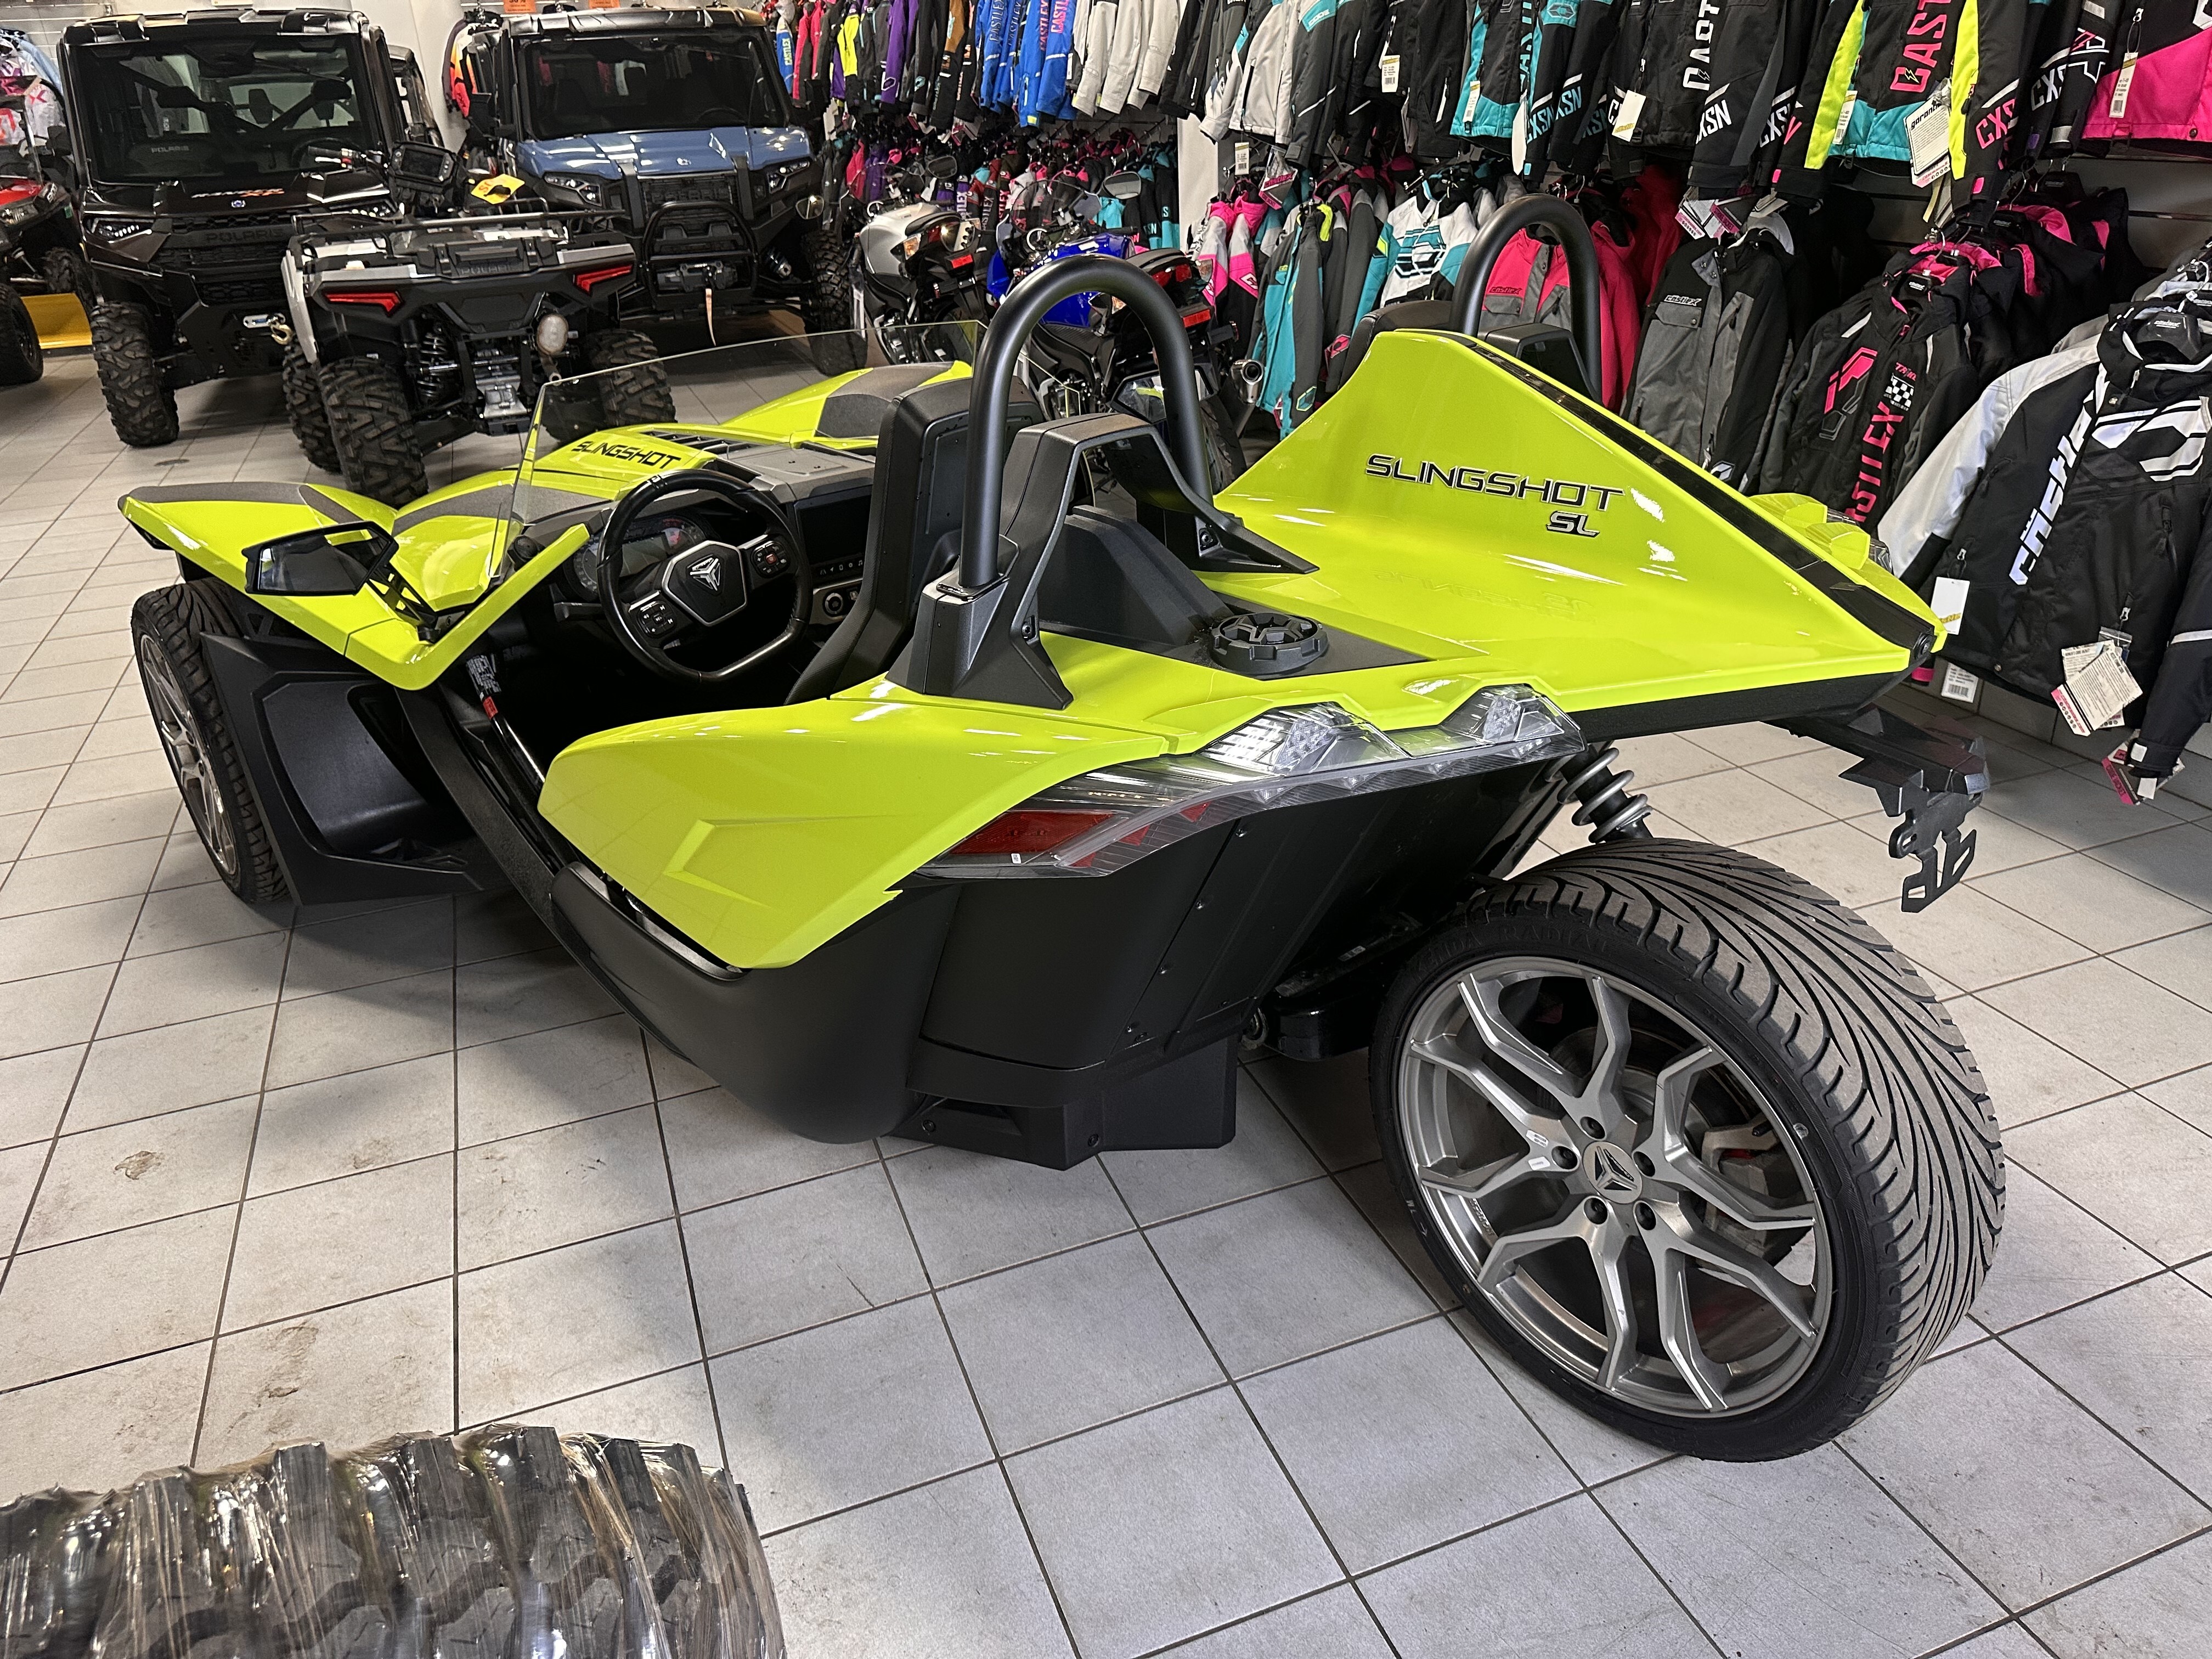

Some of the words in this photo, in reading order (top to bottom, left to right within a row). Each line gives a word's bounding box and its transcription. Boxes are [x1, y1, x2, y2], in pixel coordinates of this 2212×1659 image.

[571, 441, 681, 469] SLINGSHOT
[1365, 453, 1626, 511] SLINGSHOT
[1546, 510, 1600, 538] SL
